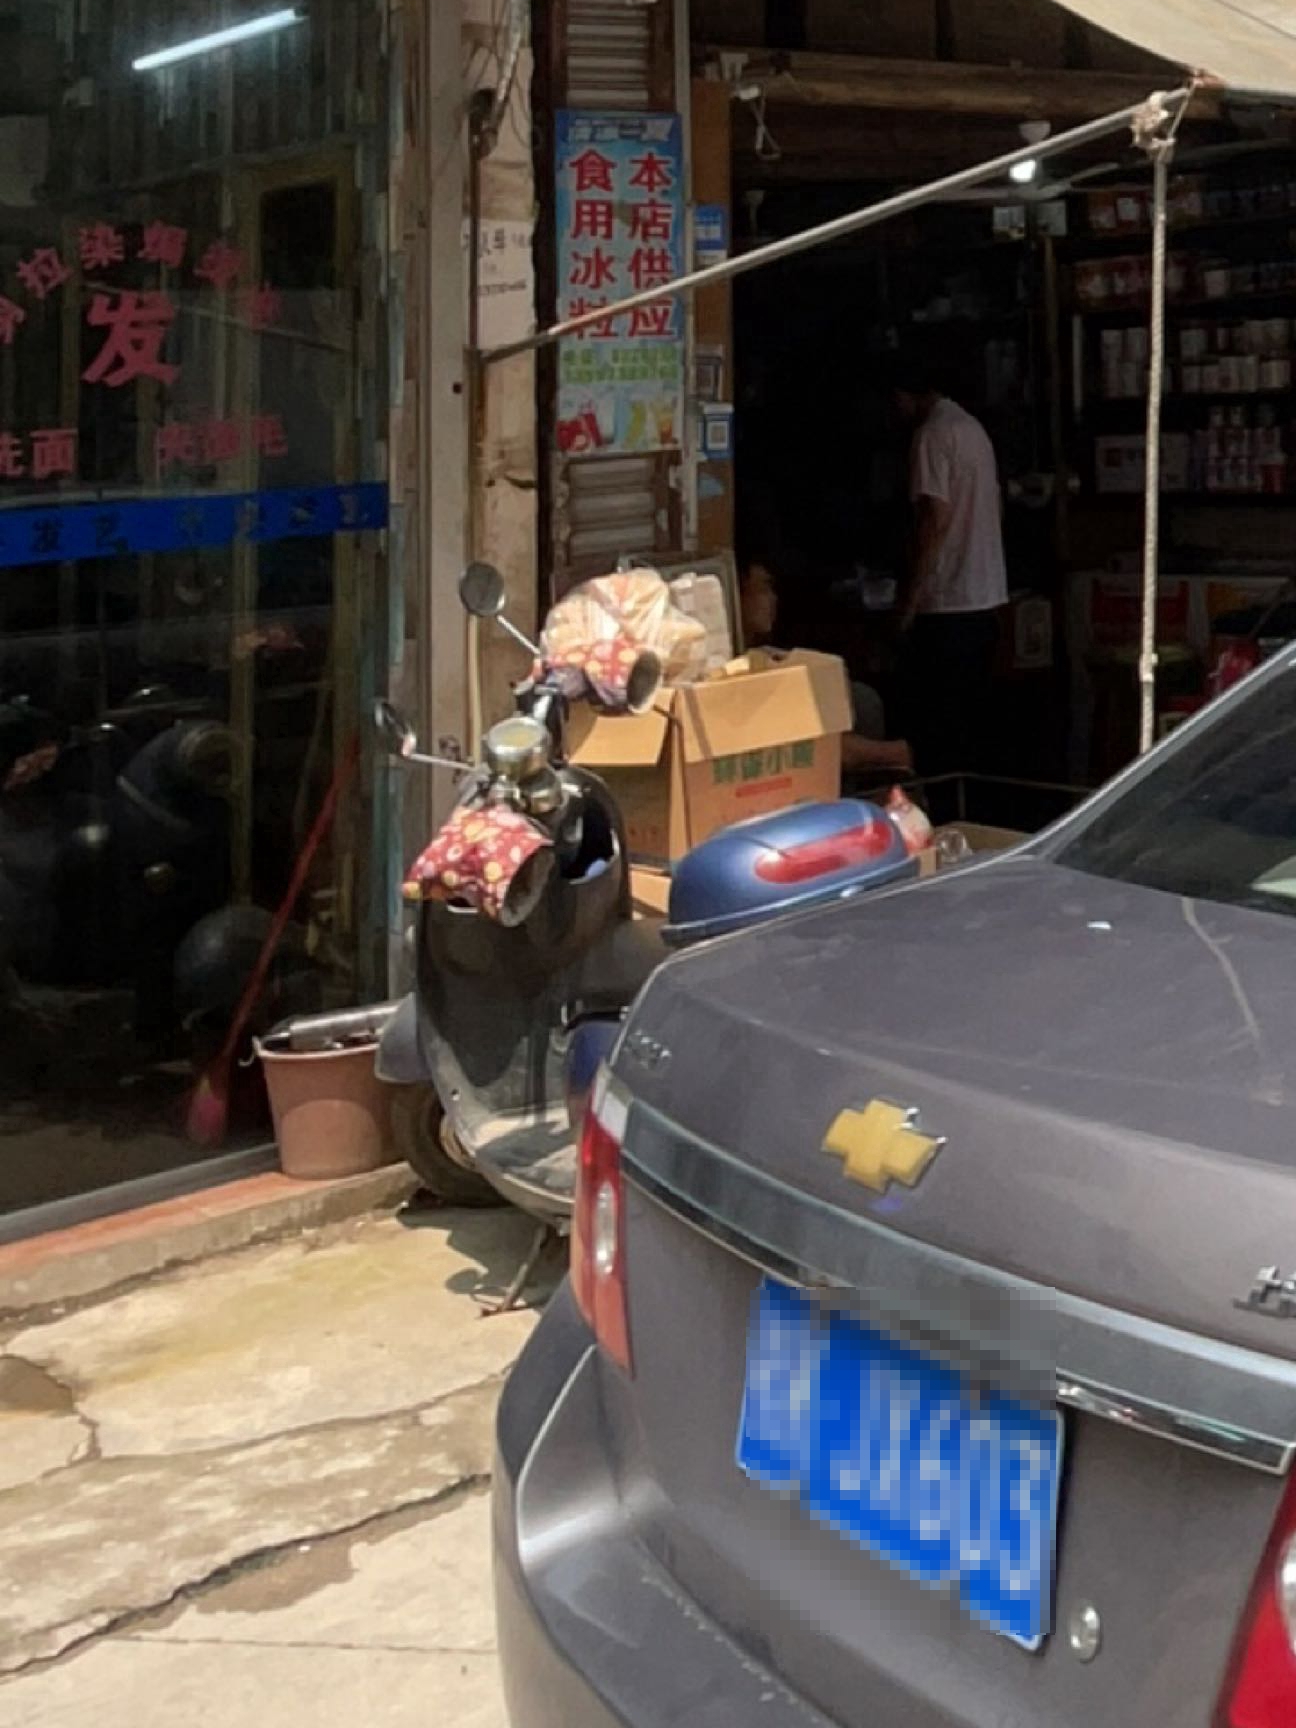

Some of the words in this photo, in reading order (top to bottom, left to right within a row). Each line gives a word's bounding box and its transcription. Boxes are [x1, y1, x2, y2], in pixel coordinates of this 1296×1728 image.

[569, 149, 618, 340] 食用冰粒
[628, 152, 674, 338] 本店供应
